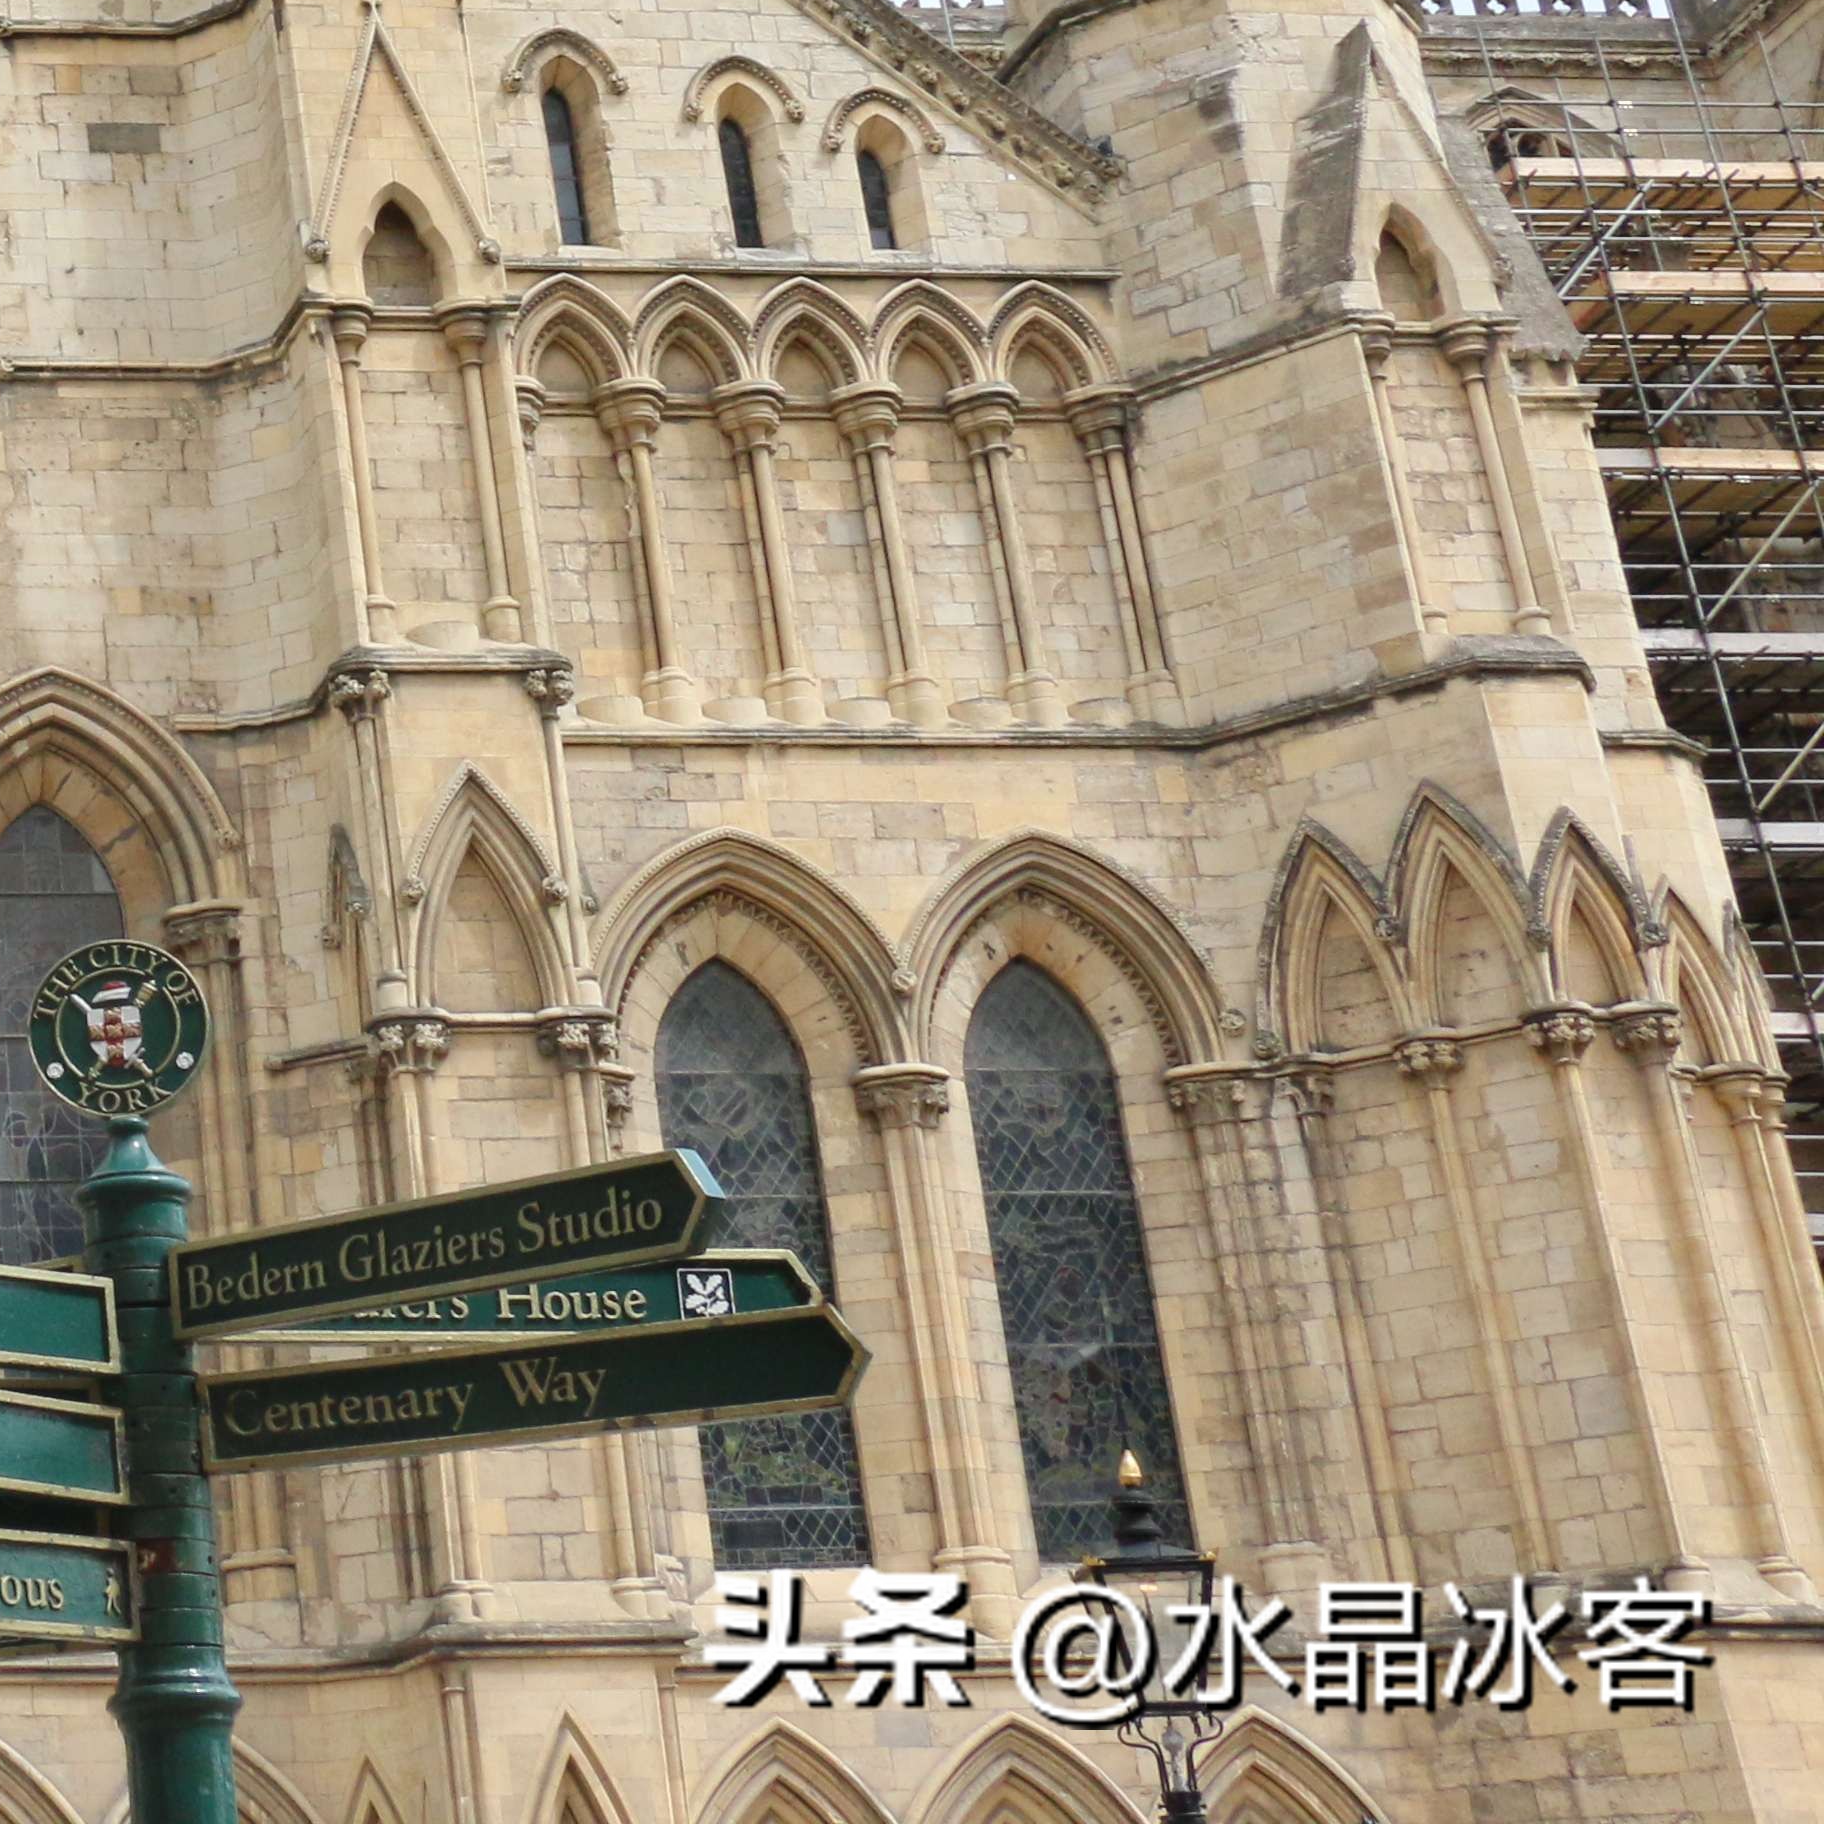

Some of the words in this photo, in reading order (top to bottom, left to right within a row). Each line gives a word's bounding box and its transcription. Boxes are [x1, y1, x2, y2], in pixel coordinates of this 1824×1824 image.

[33, 959, 84, 1019] THE
[88, 945, 168, 973] CITY
[166, 970, 199, 1005] OF
[77, 1076, 173, 1113] YORK
[186, 1250, 327, 1311] Bedern
[338, 1224, 506, 1283] Glaziers
[517, 1186, 663, 1253] Studio
[496, 1282, 647, 1321] House
[224, 1382, 473, 1436] Centenary
[497, 1356, 606, 1416] Way
